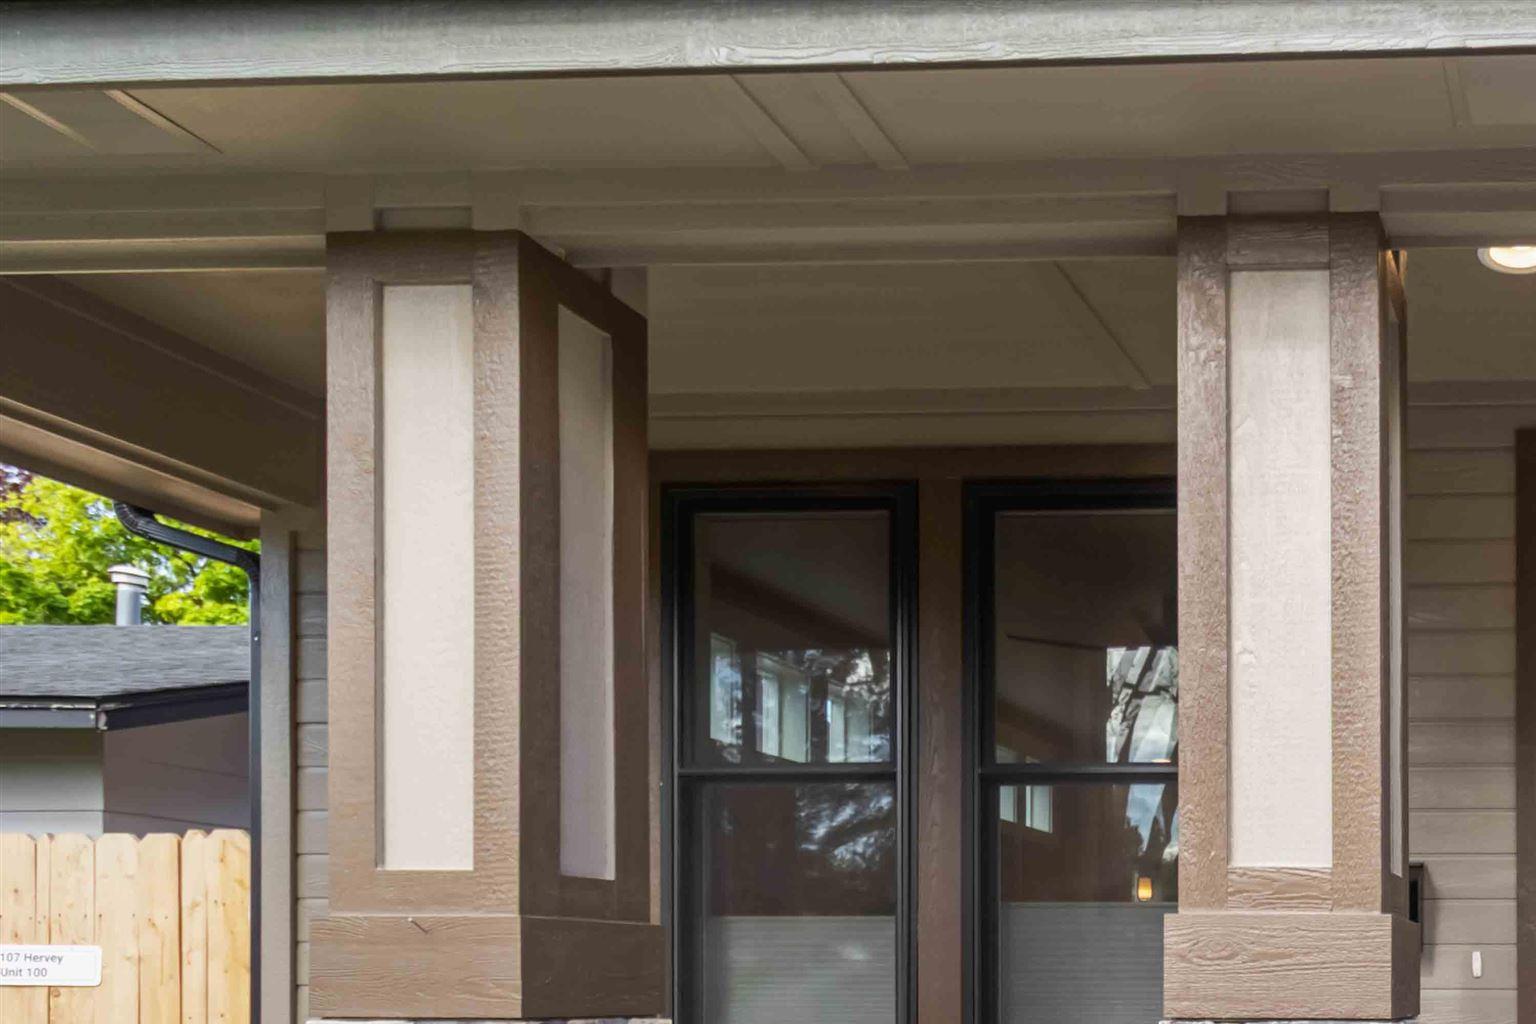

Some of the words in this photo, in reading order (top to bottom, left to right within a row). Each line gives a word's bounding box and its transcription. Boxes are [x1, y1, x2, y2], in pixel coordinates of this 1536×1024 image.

[24, 953, 64, 965] Hervey
[1, 967, 22, 977] Unit
[27, 967, 48, 977] 100
